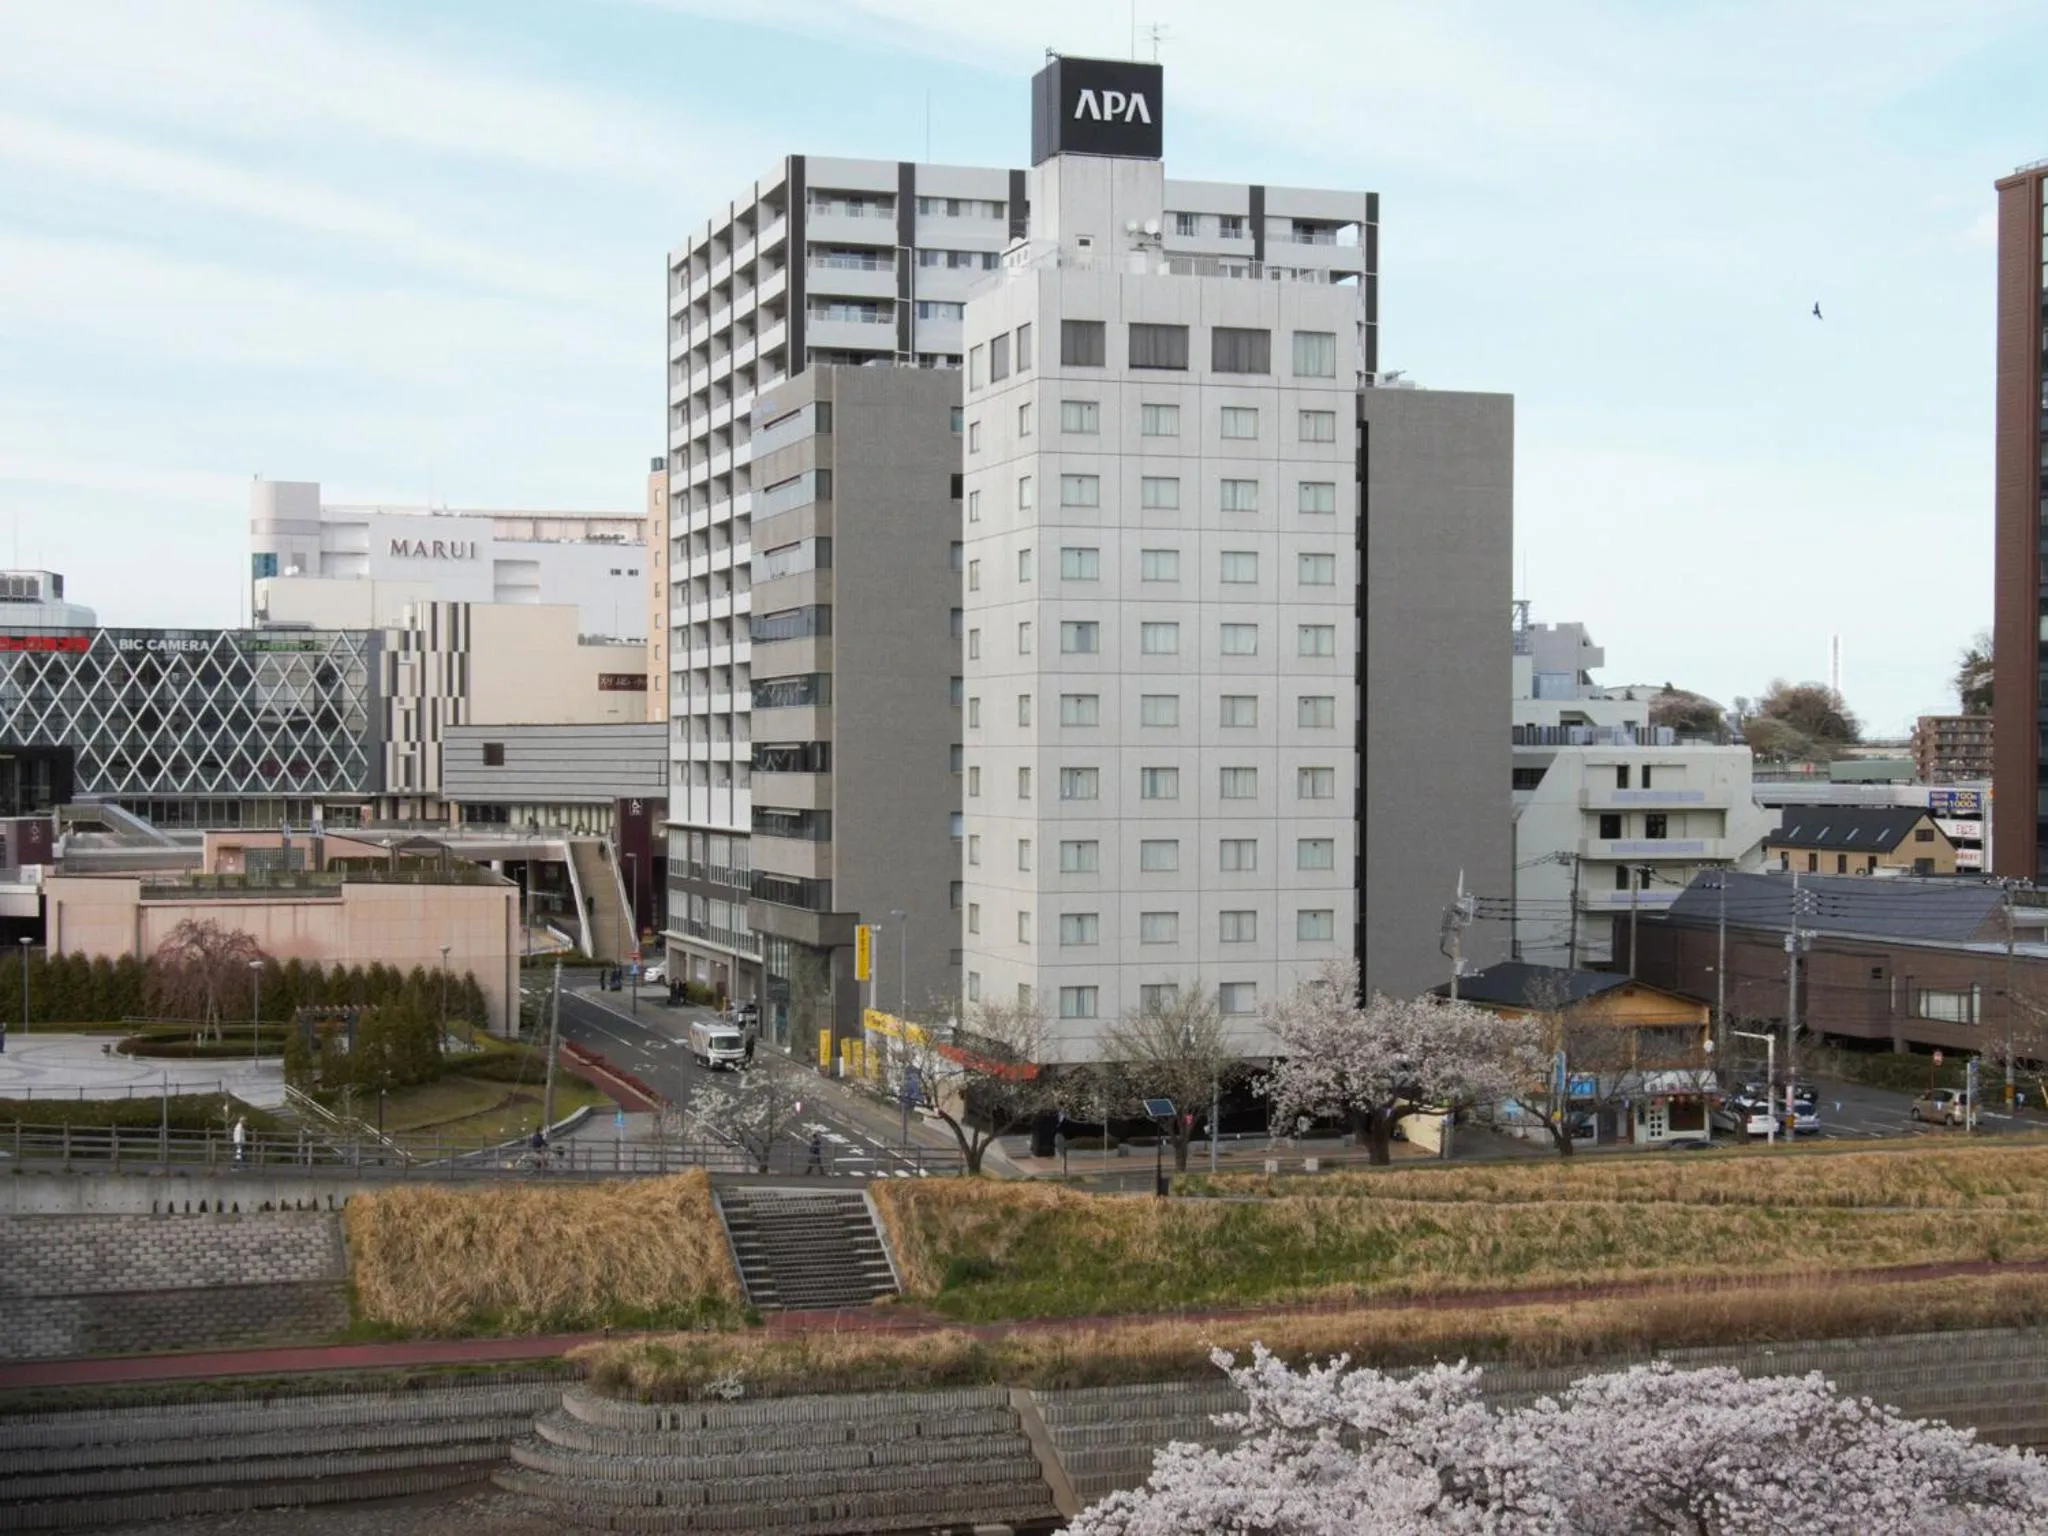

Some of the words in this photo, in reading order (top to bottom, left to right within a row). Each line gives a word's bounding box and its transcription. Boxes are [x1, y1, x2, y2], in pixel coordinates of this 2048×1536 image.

[1074, 88, 1152, 124] APA
[390, 538, 475, 560] MARUI
[119, 638, 145, 651] BIC
[146, 639, 210, 652] CAMERA
